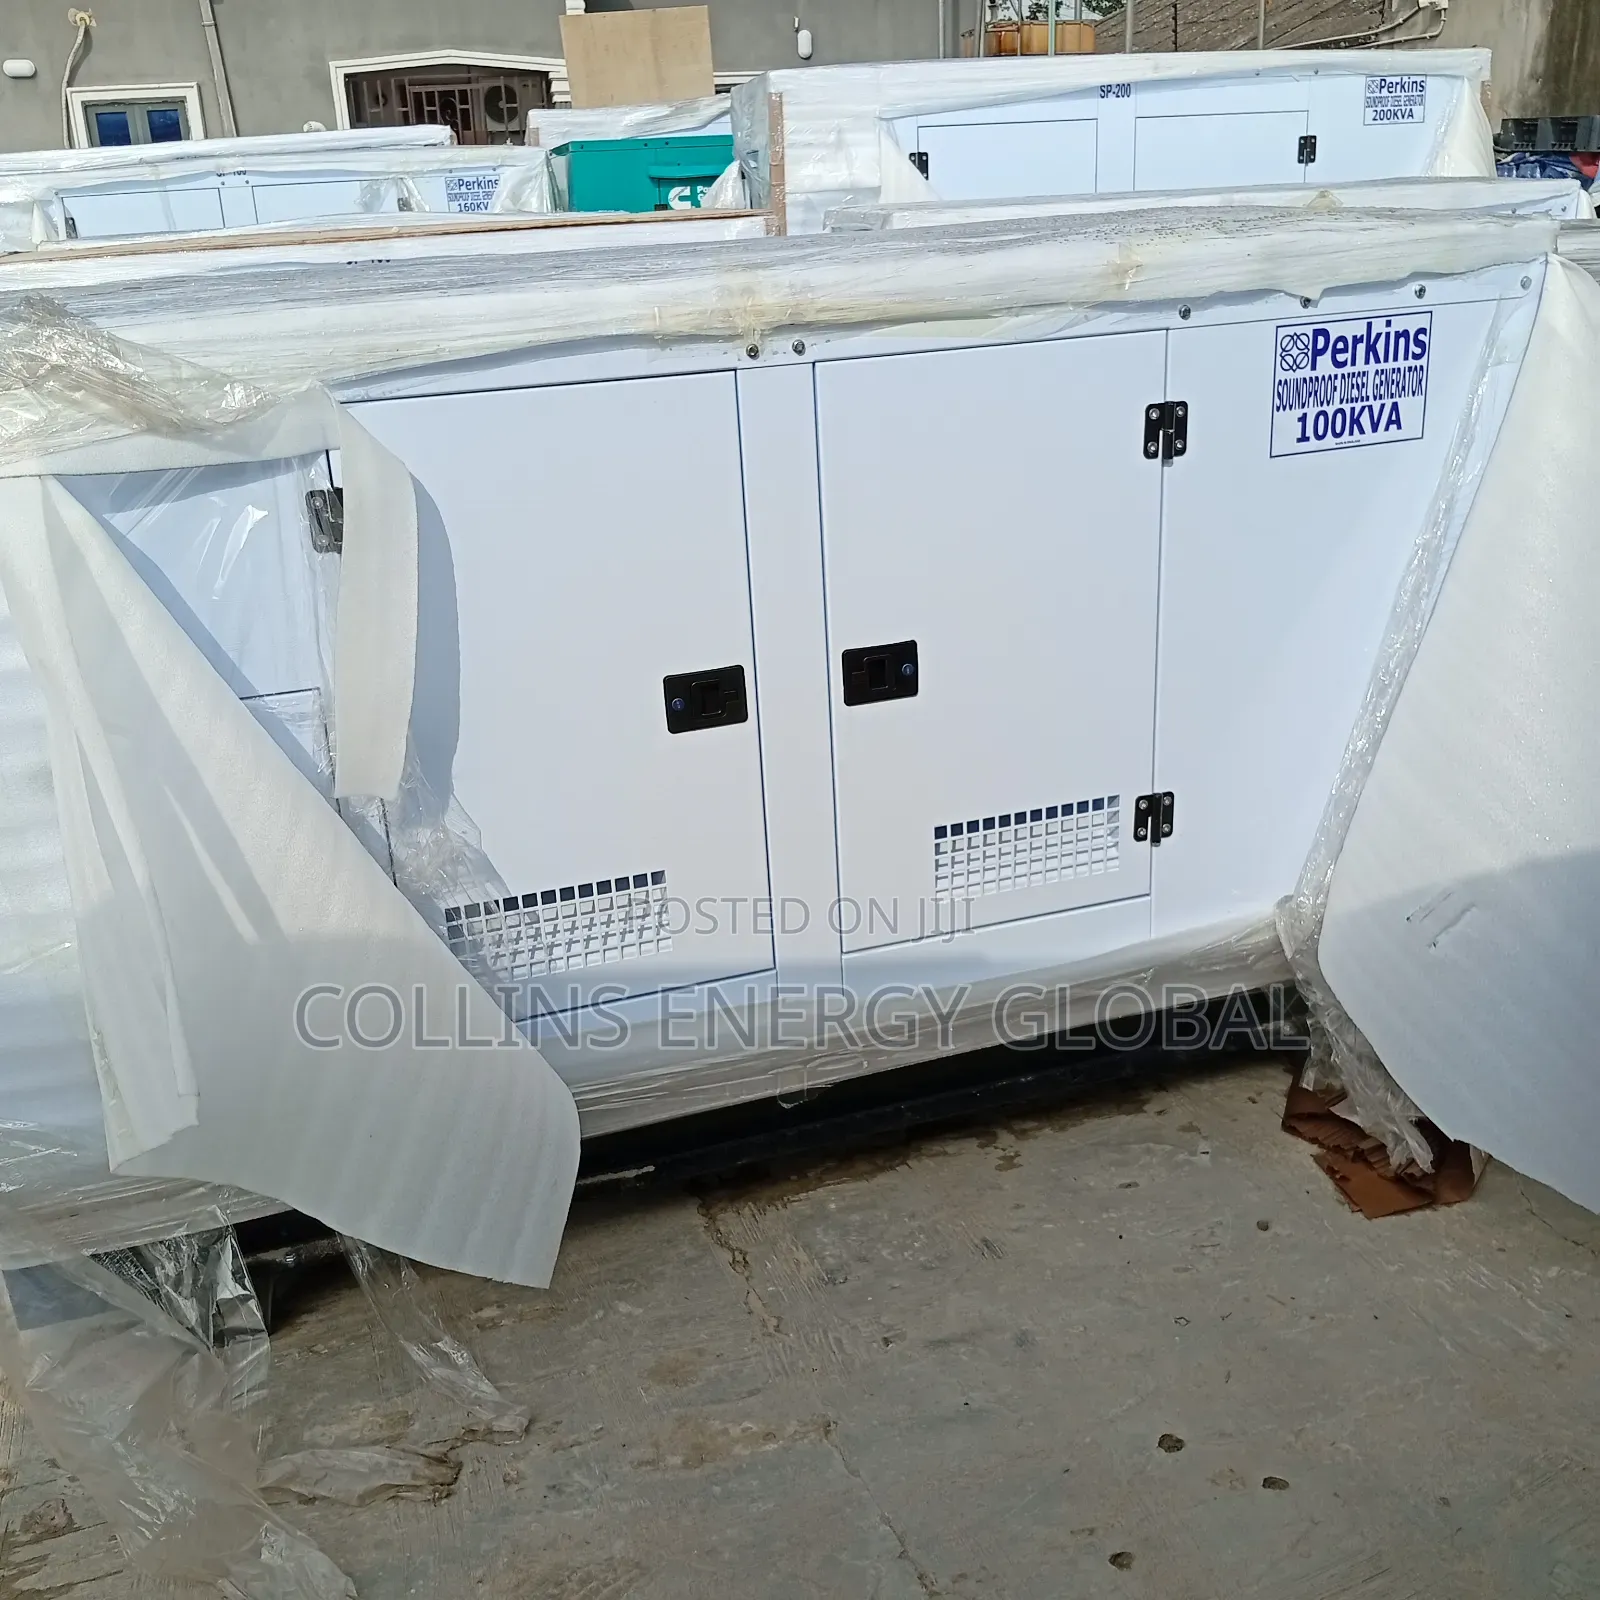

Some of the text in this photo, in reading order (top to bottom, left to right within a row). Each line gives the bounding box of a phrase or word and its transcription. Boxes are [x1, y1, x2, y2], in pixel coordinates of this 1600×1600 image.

[1099, 83, 1132, 99] SP-200
[1379, 76, 1425, 94] Perkins
[1371, 107, 1415, 122] 200KVA
[457, 176, 500, 191] Perkins
[1310, 319, 1428, 372] Perkins
[1275, 364, 1425, 413] SOUNDPROOF DIESEL GENERATOR
[1296, 401, 1403, 444] 100KVA
